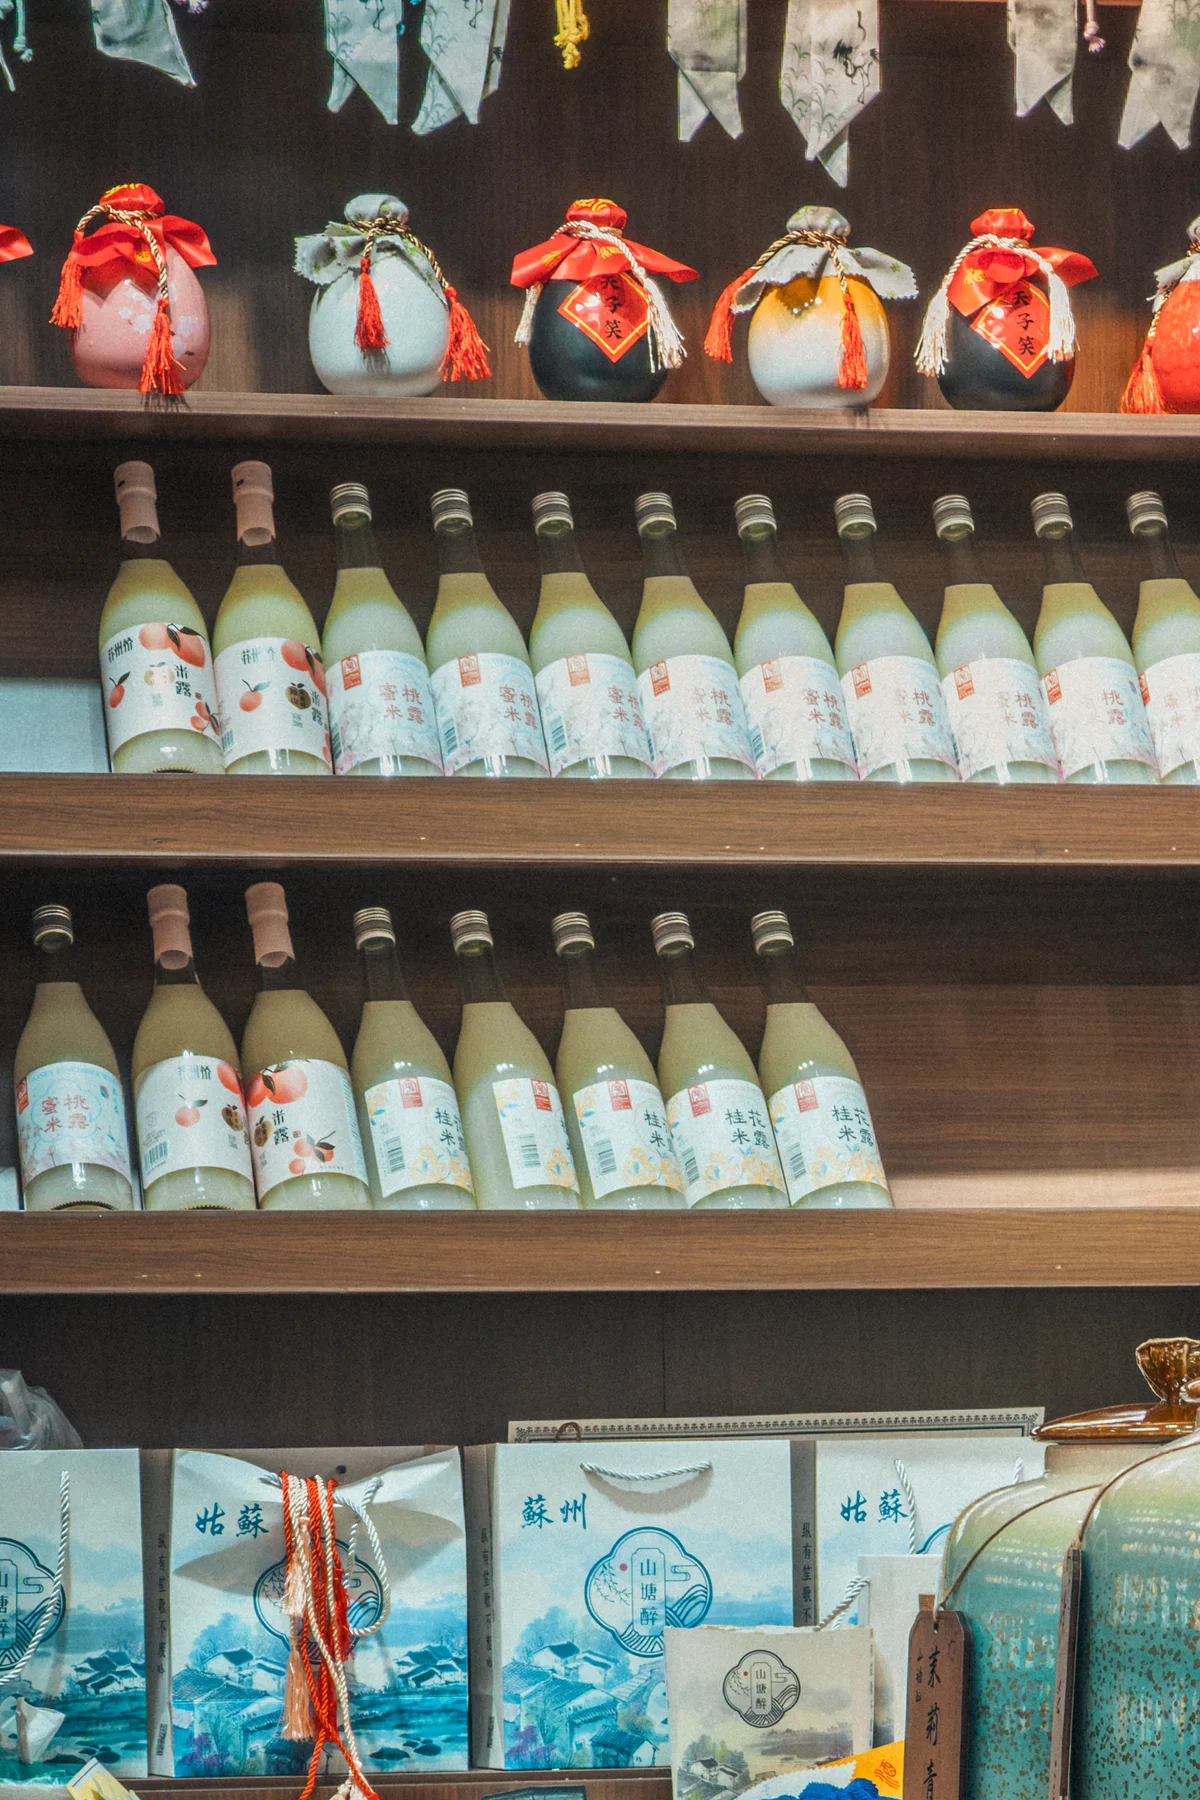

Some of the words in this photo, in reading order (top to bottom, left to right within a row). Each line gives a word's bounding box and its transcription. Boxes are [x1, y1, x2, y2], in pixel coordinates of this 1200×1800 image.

[1012, 291, 1035, 356] 天子笑
[725, 1108, 768, 1130] 桂花
[832, 1105, 872, 1128] 桂花
[195, 1502, 271, 1538] 姑蘇
[521, 1492, 588, 1531] 蘇州
[840, 1490, 910, 1523] 姑蘇
[639, 1557, 660, 1627] 山塘醉
[755, 1668, 768, 1710] 山塘醉
